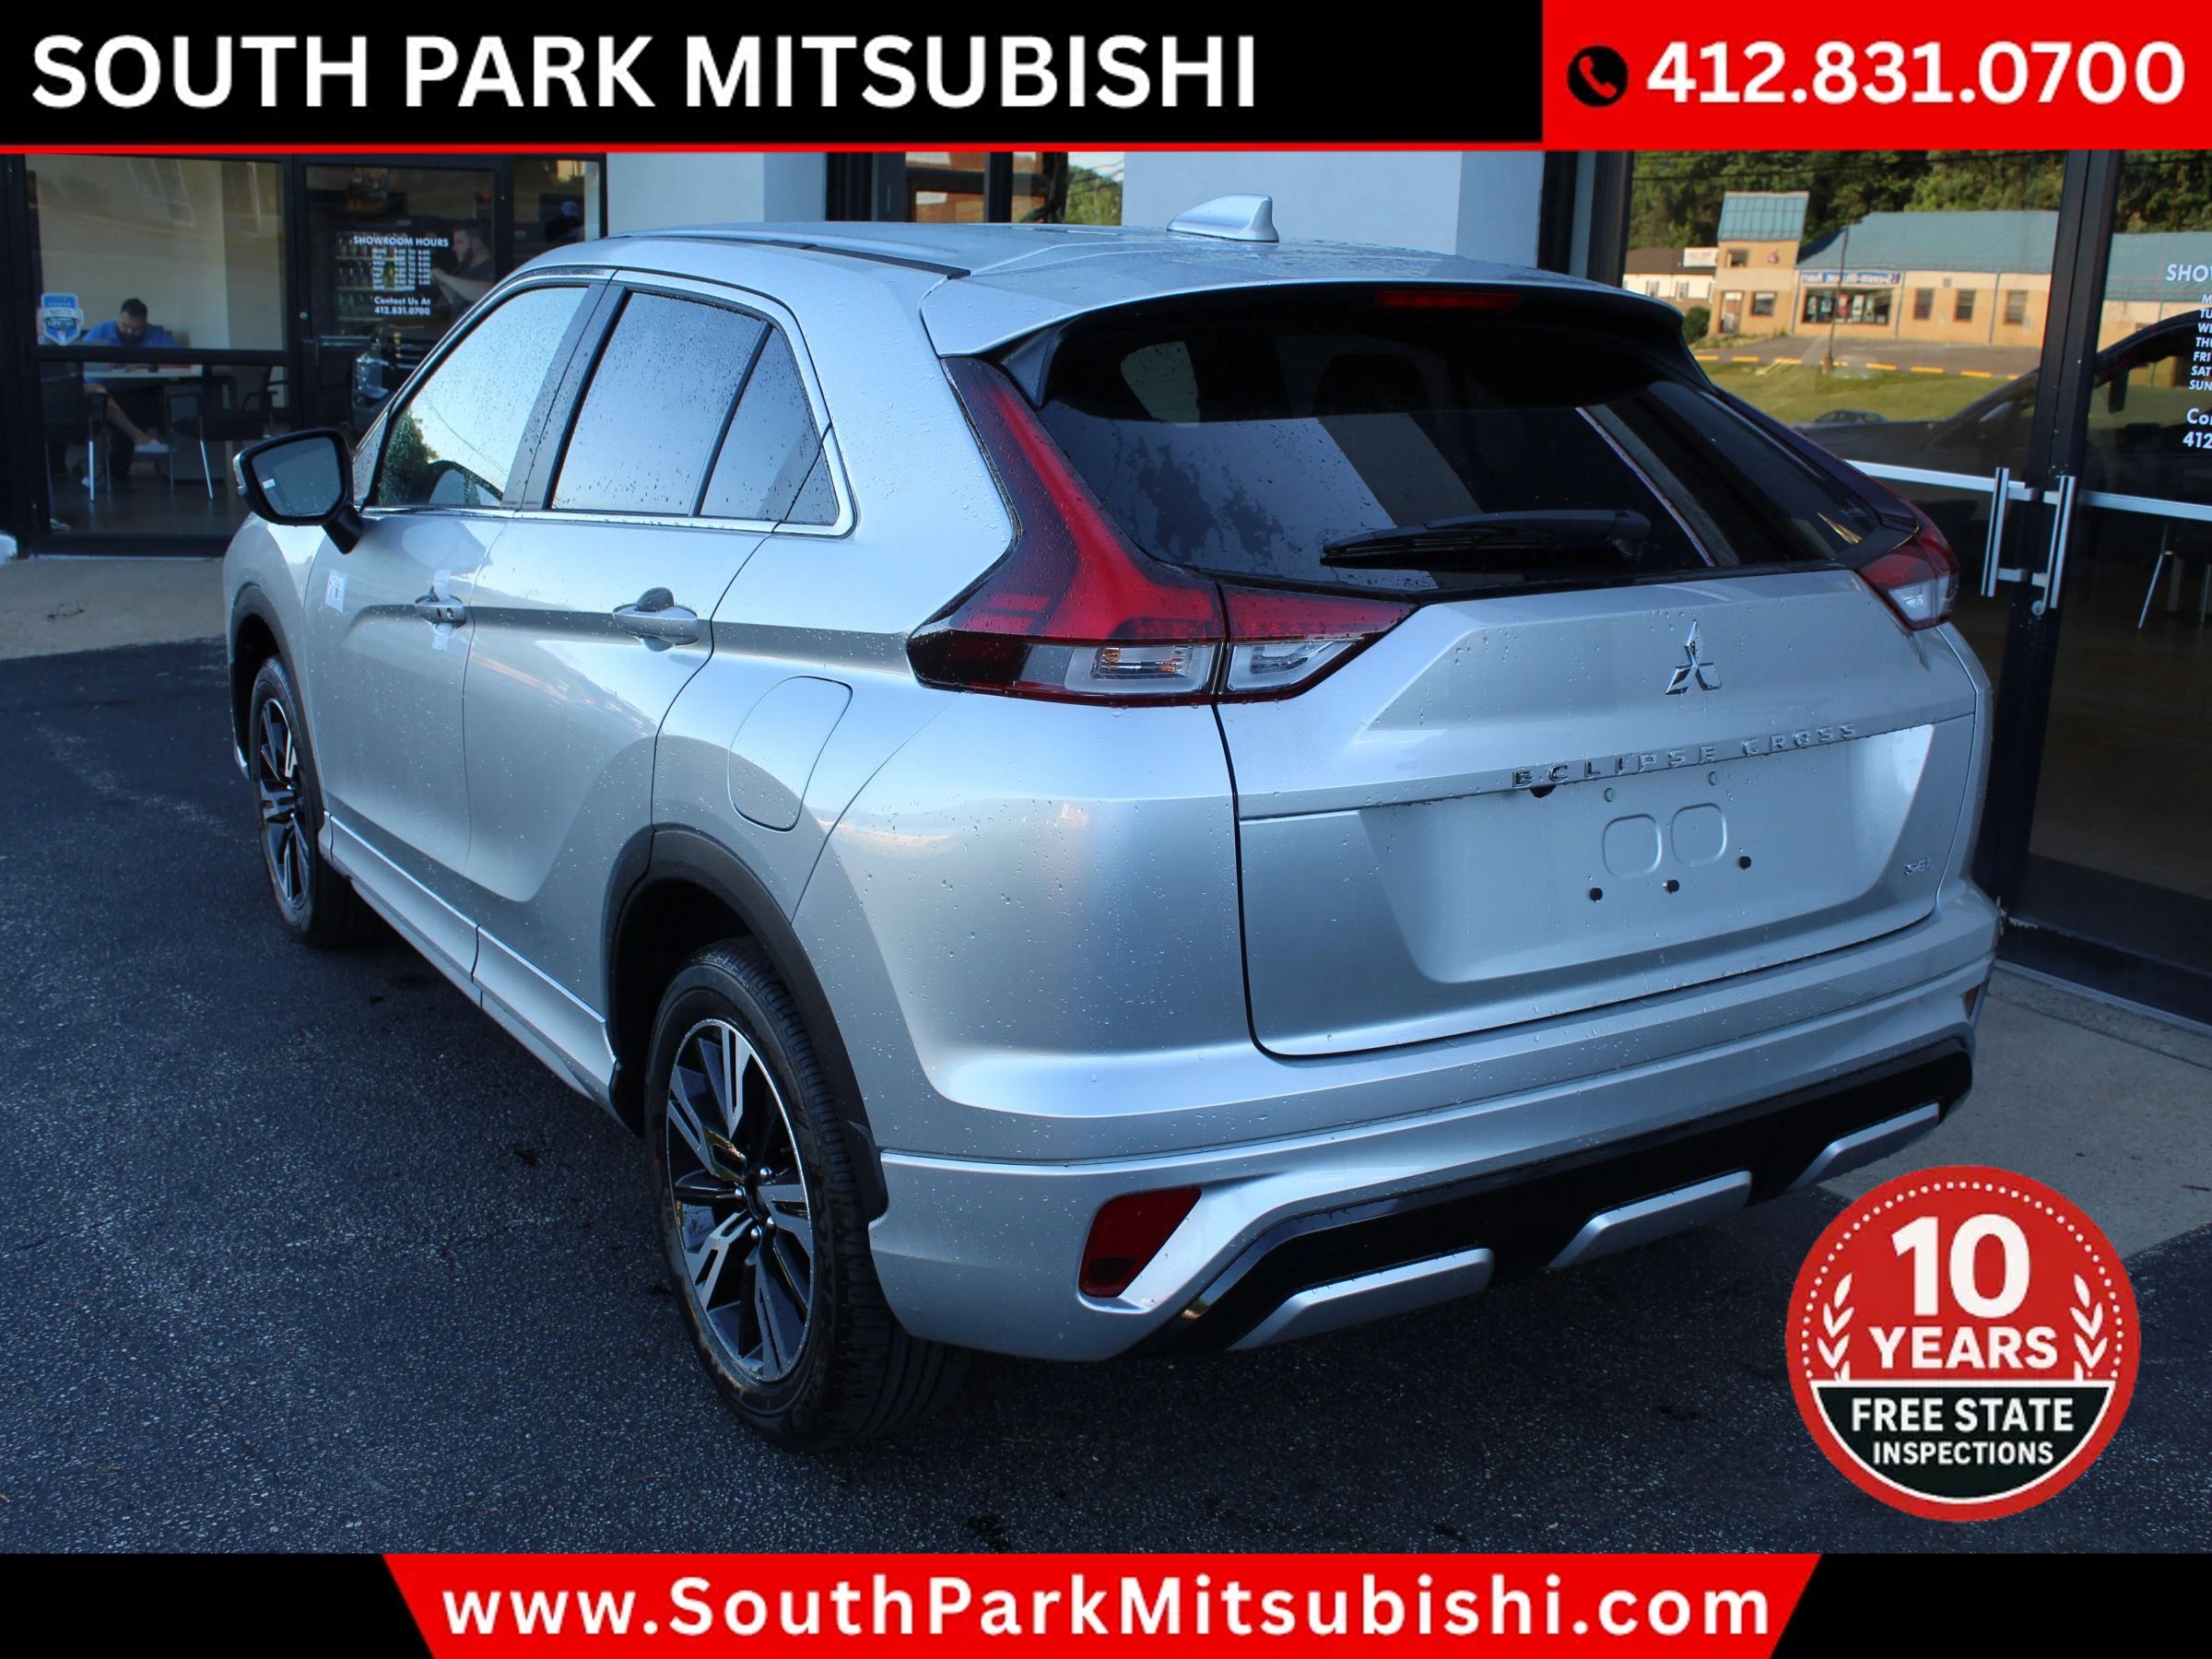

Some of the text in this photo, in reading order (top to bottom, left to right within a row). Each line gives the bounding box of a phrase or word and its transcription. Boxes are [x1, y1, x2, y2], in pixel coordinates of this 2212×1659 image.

[354, 236, 449, 247] SHOWROOM HOURS
[2166, 264, 2212, 283] SHO
[374, 296, 430, 305] Contact Us At
[374, 306, 430, 315] 412.831.0700
[2194, 351, 2211, 362] FRI
[2191, 365, 2212, 376] SAT
[2189, 380, 2212, 391] SUN
[1512, 723, 1856, 790] ECLIPSE CROSS
